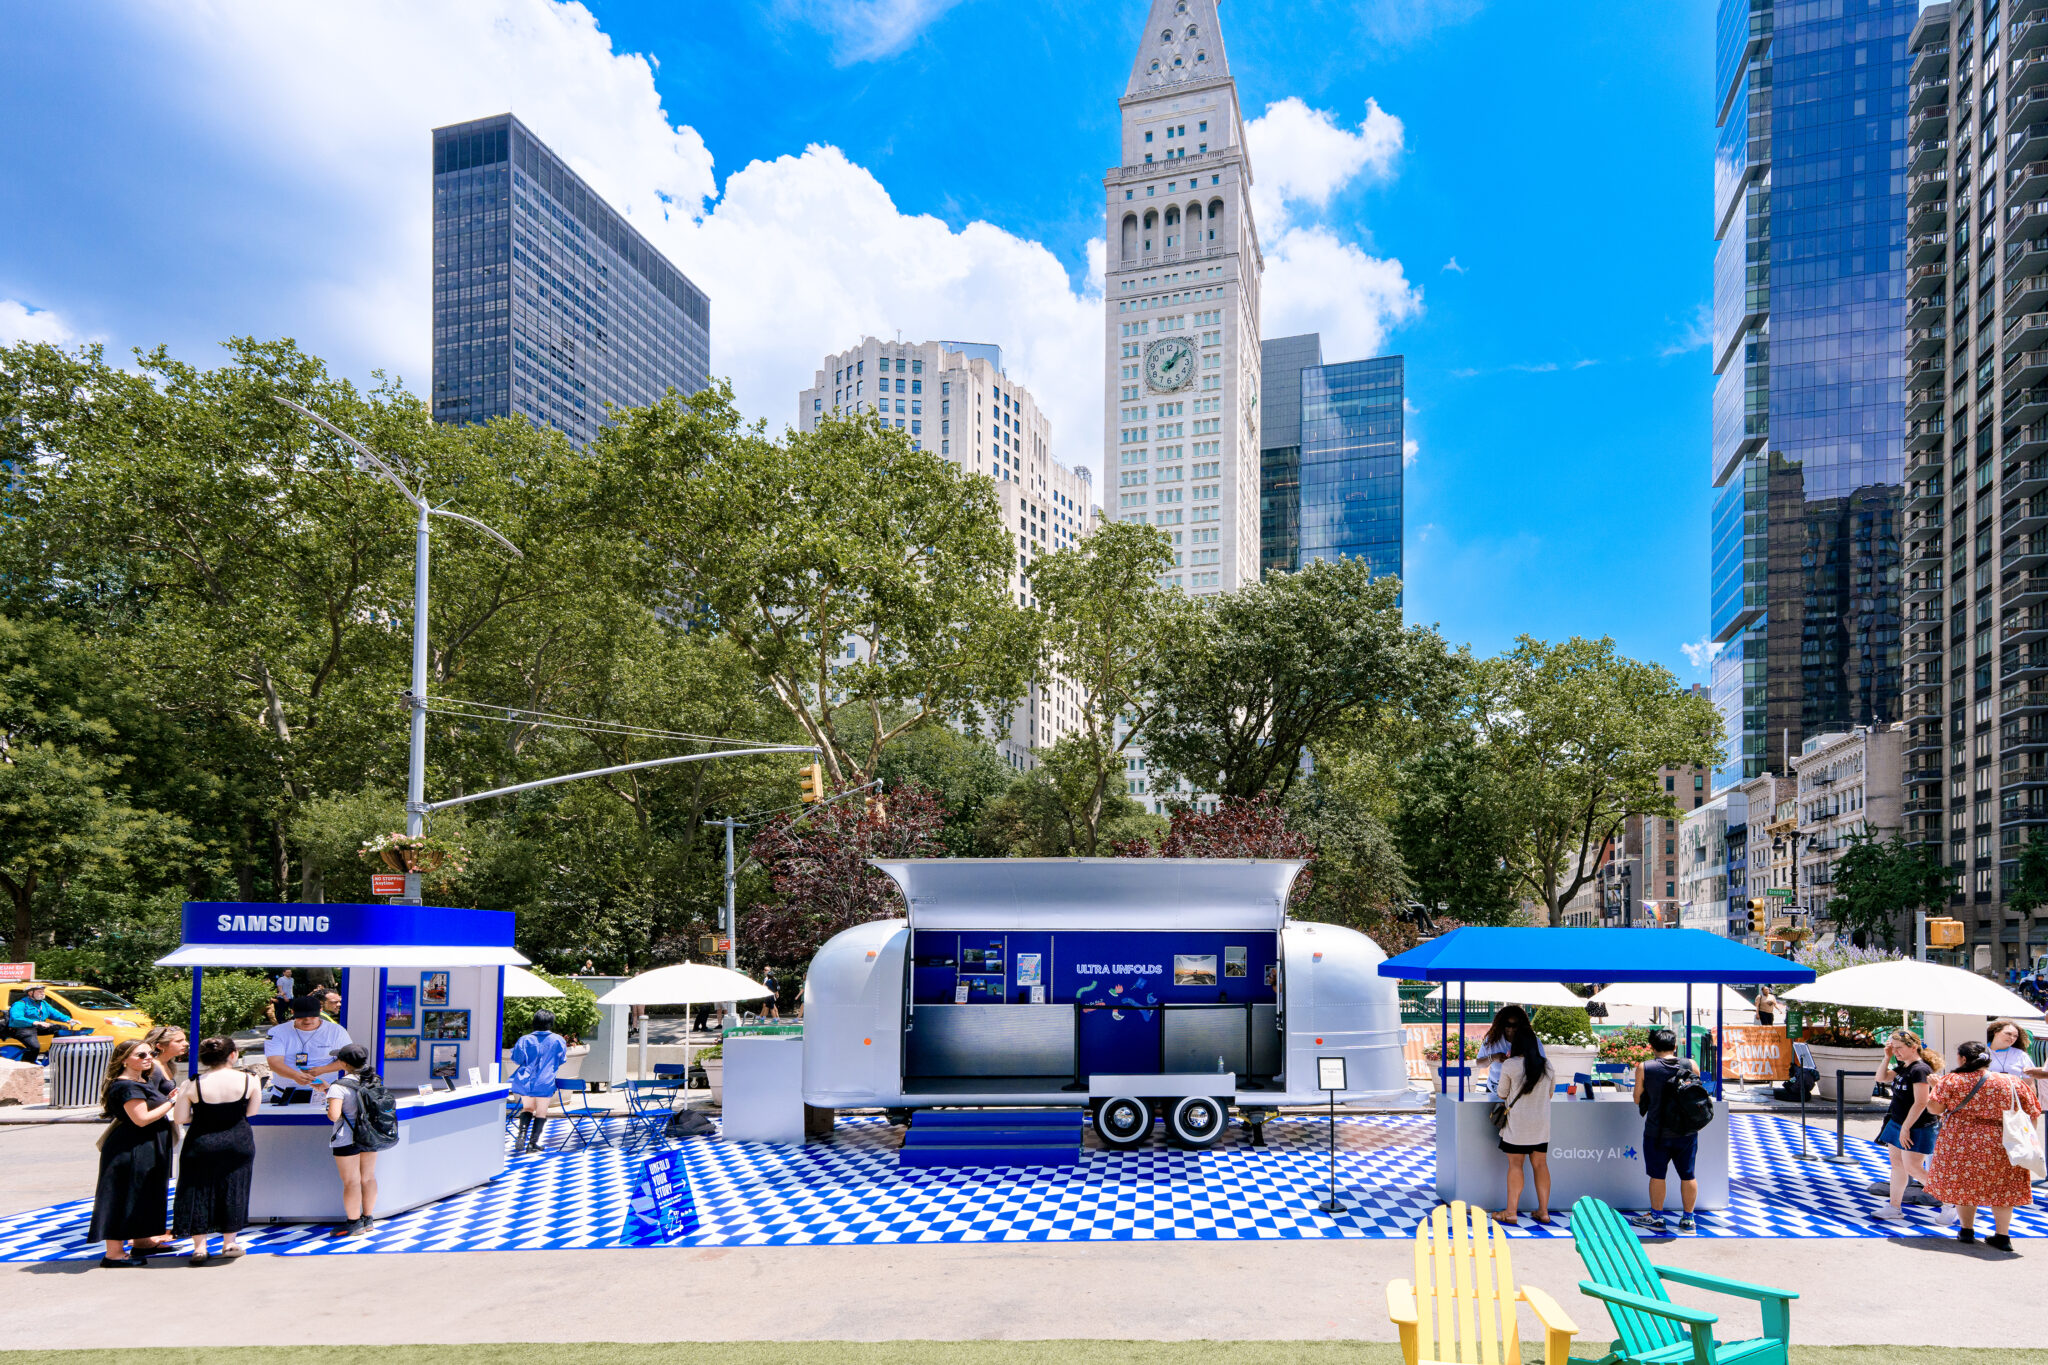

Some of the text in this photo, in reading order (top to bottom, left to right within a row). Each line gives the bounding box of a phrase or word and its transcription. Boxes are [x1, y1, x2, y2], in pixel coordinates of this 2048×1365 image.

[1185, 358, 1189, 366] 3
[1153, 370, 1157, 378] 8
[217, 914, 329, 932] SAMSUNG
[1076, 964, 1162, 974] ULTRA UNFOLDS
[1722, 1029, 1744, 1043] THE
[1735, 1044, 1780, 1059] NOMAD
[1730, 1060, 1773, 1075] PIAZZA
[1552, 1147, 1620, 1163] Galaxy AI
[649, 1158, 670, 1175] UNFOLD
[652, 1172, 668, 1187] YOUR
[655, 1183, 672, 1199] STORY
